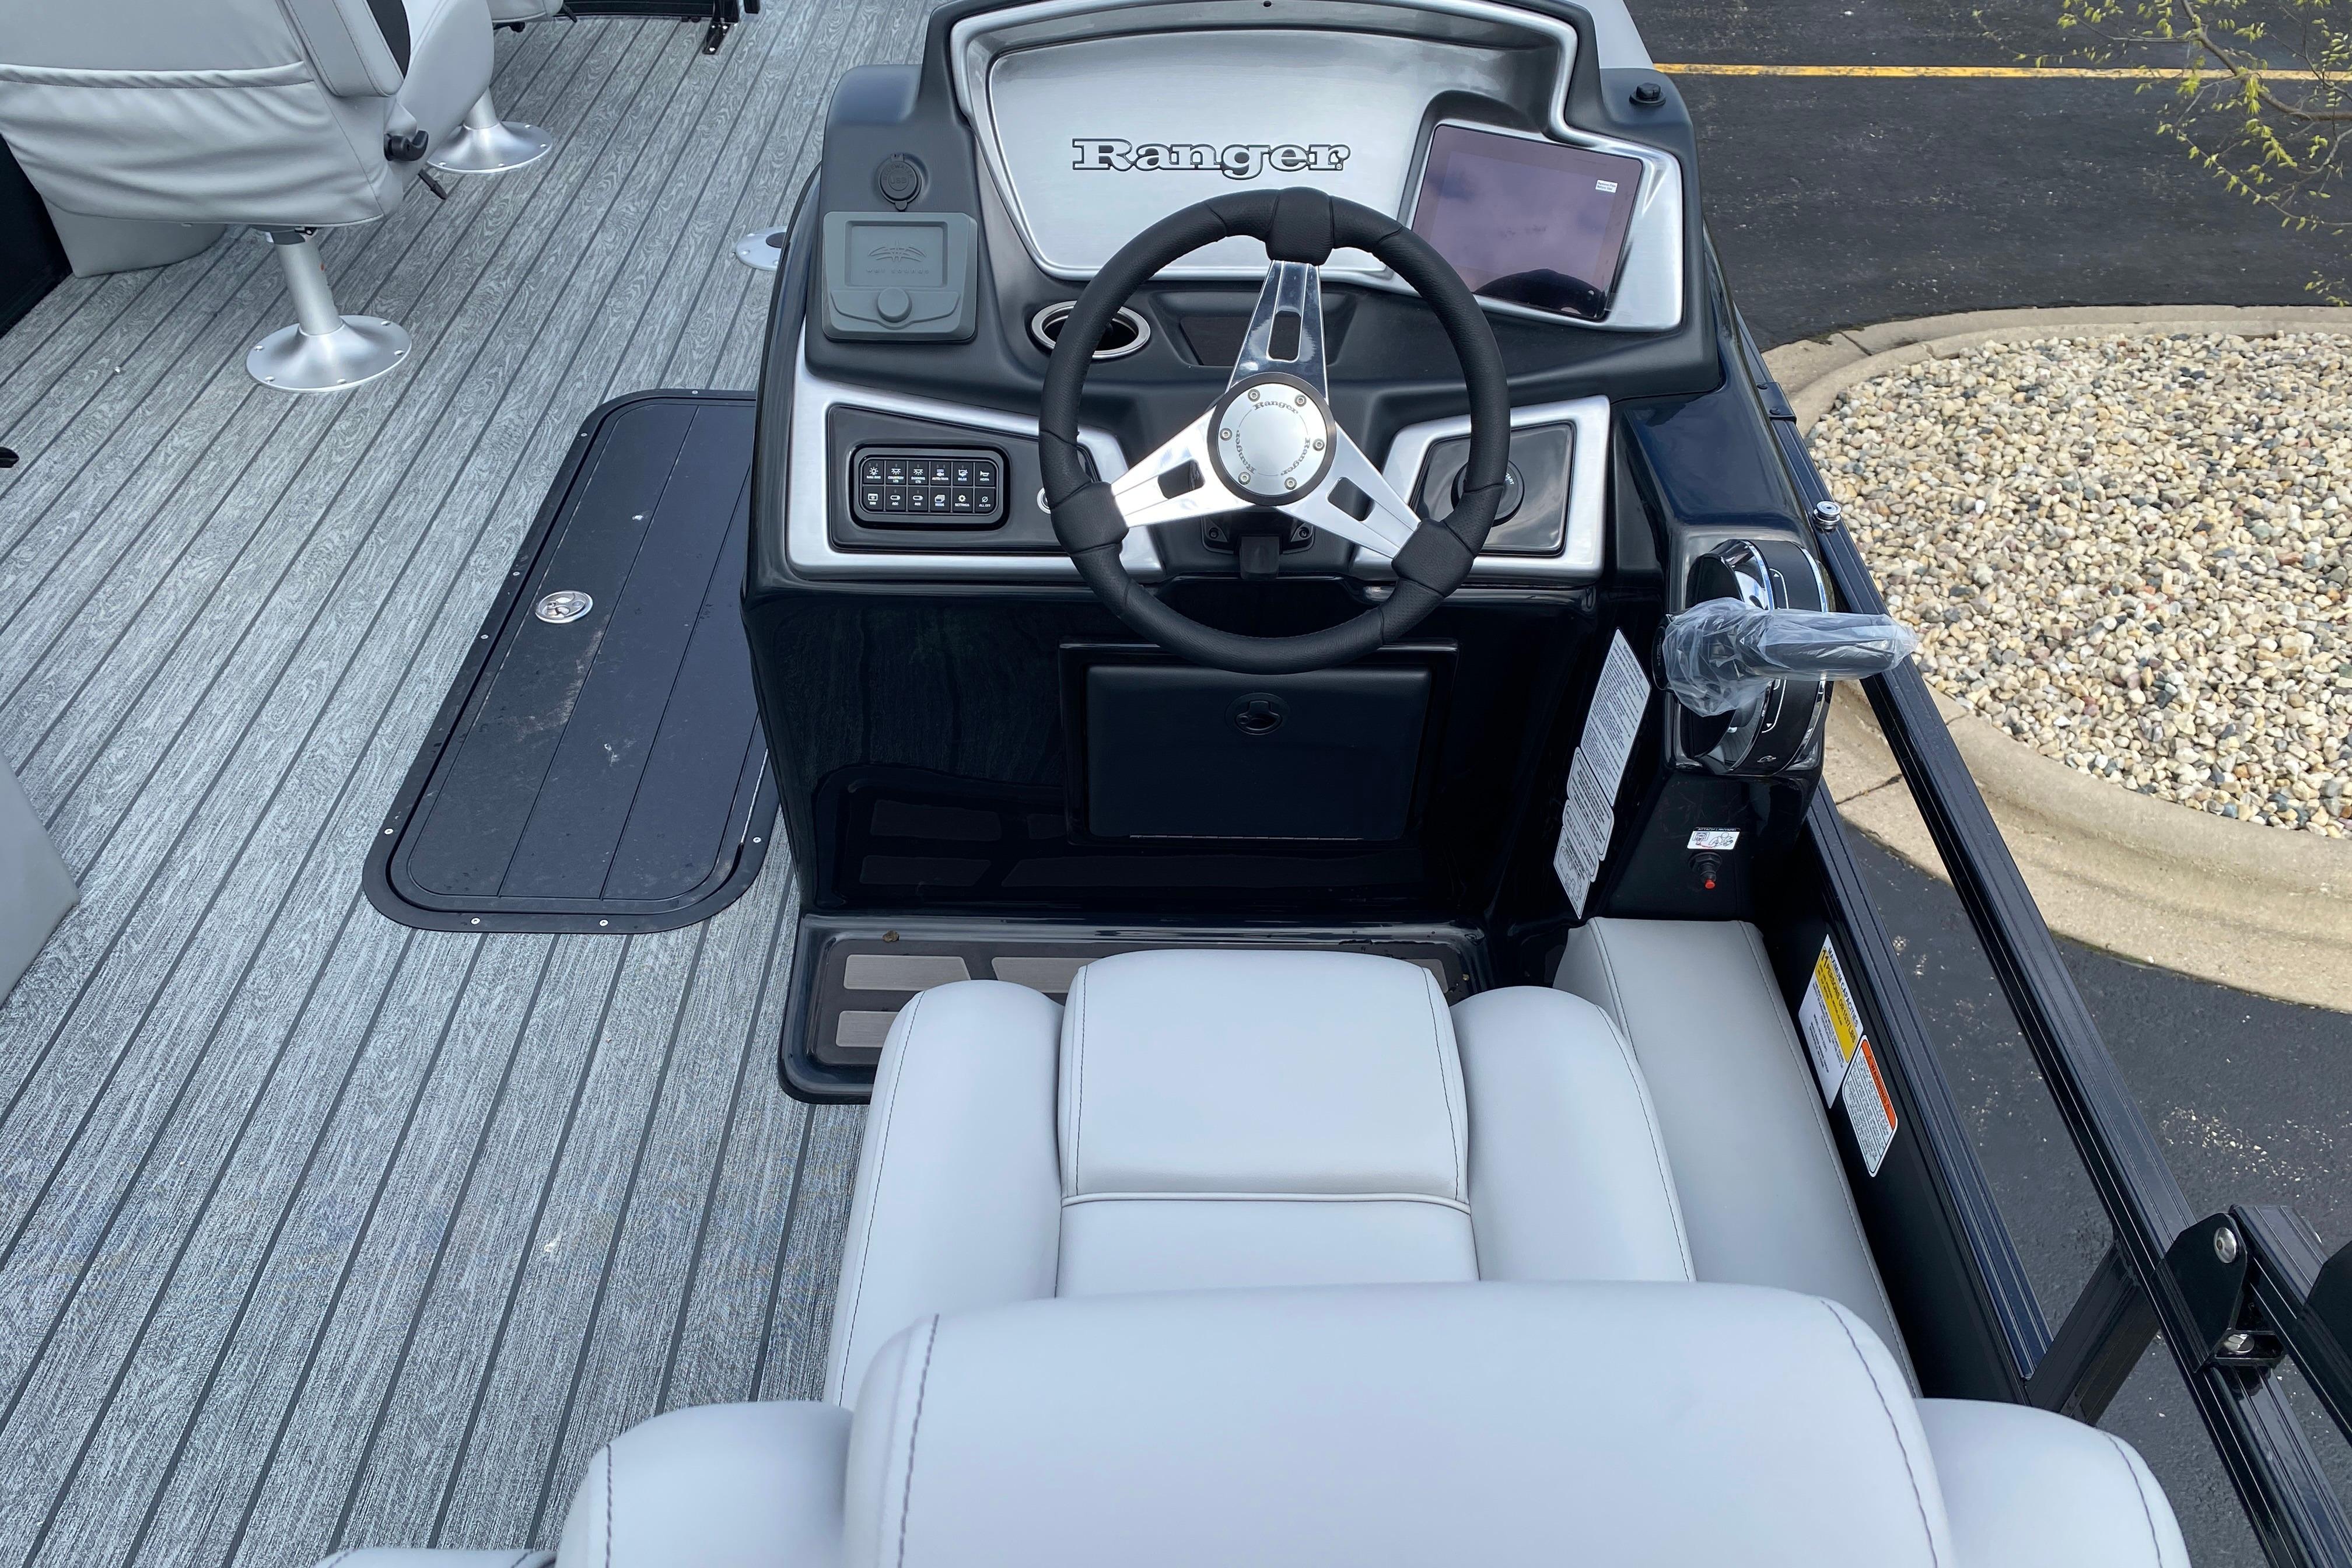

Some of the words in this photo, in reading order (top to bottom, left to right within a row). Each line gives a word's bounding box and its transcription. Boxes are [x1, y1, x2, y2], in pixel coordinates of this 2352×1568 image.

[890, 175, 907, 184] USB
[1072, 138, 1351, 180] Ranger
[1252, 400, 1298, 415] Ranger
[1234, 429, 1257, 475] Ranger
[1280, 438, 1311, 476] Ranger
[1821, 949, 1829, 968] 11
[1826, 964, 1840, 1000] PERSONS
[1838, 998, 1845, 1012] OR
[1828, 947, 1842, 984] MAXIMUM
[1840, 981, 1859, 1028] CAPACITIES
[1871, 1063, 1887, 1104] WARNING
